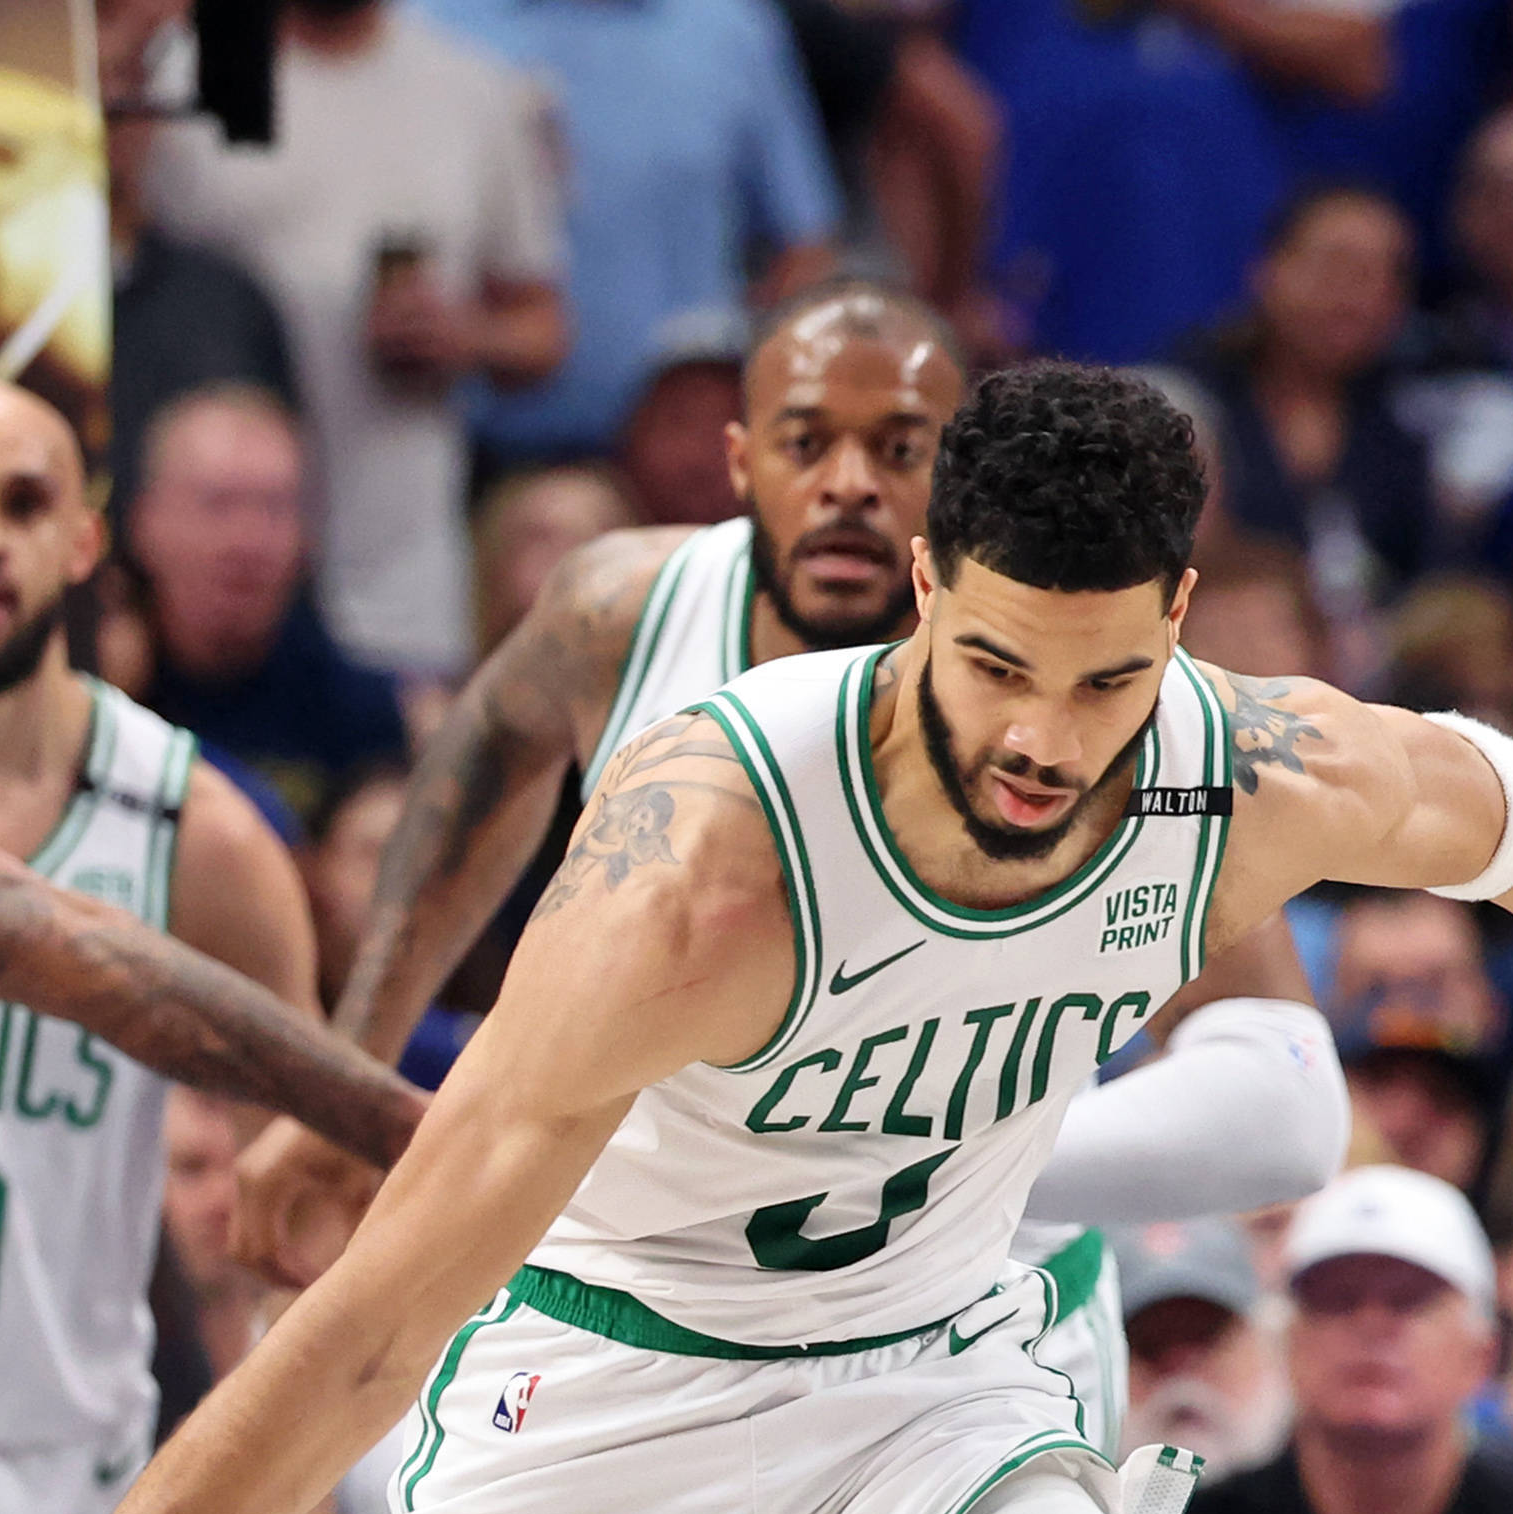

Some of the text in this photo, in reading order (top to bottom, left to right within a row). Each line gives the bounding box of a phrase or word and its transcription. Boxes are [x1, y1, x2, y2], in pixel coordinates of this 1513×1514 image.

[1141, 790, 1208, 814] WALTON
[1105, 883, 1178, 927] VISTA
[1099, 915, 1175, 953] PRINT
